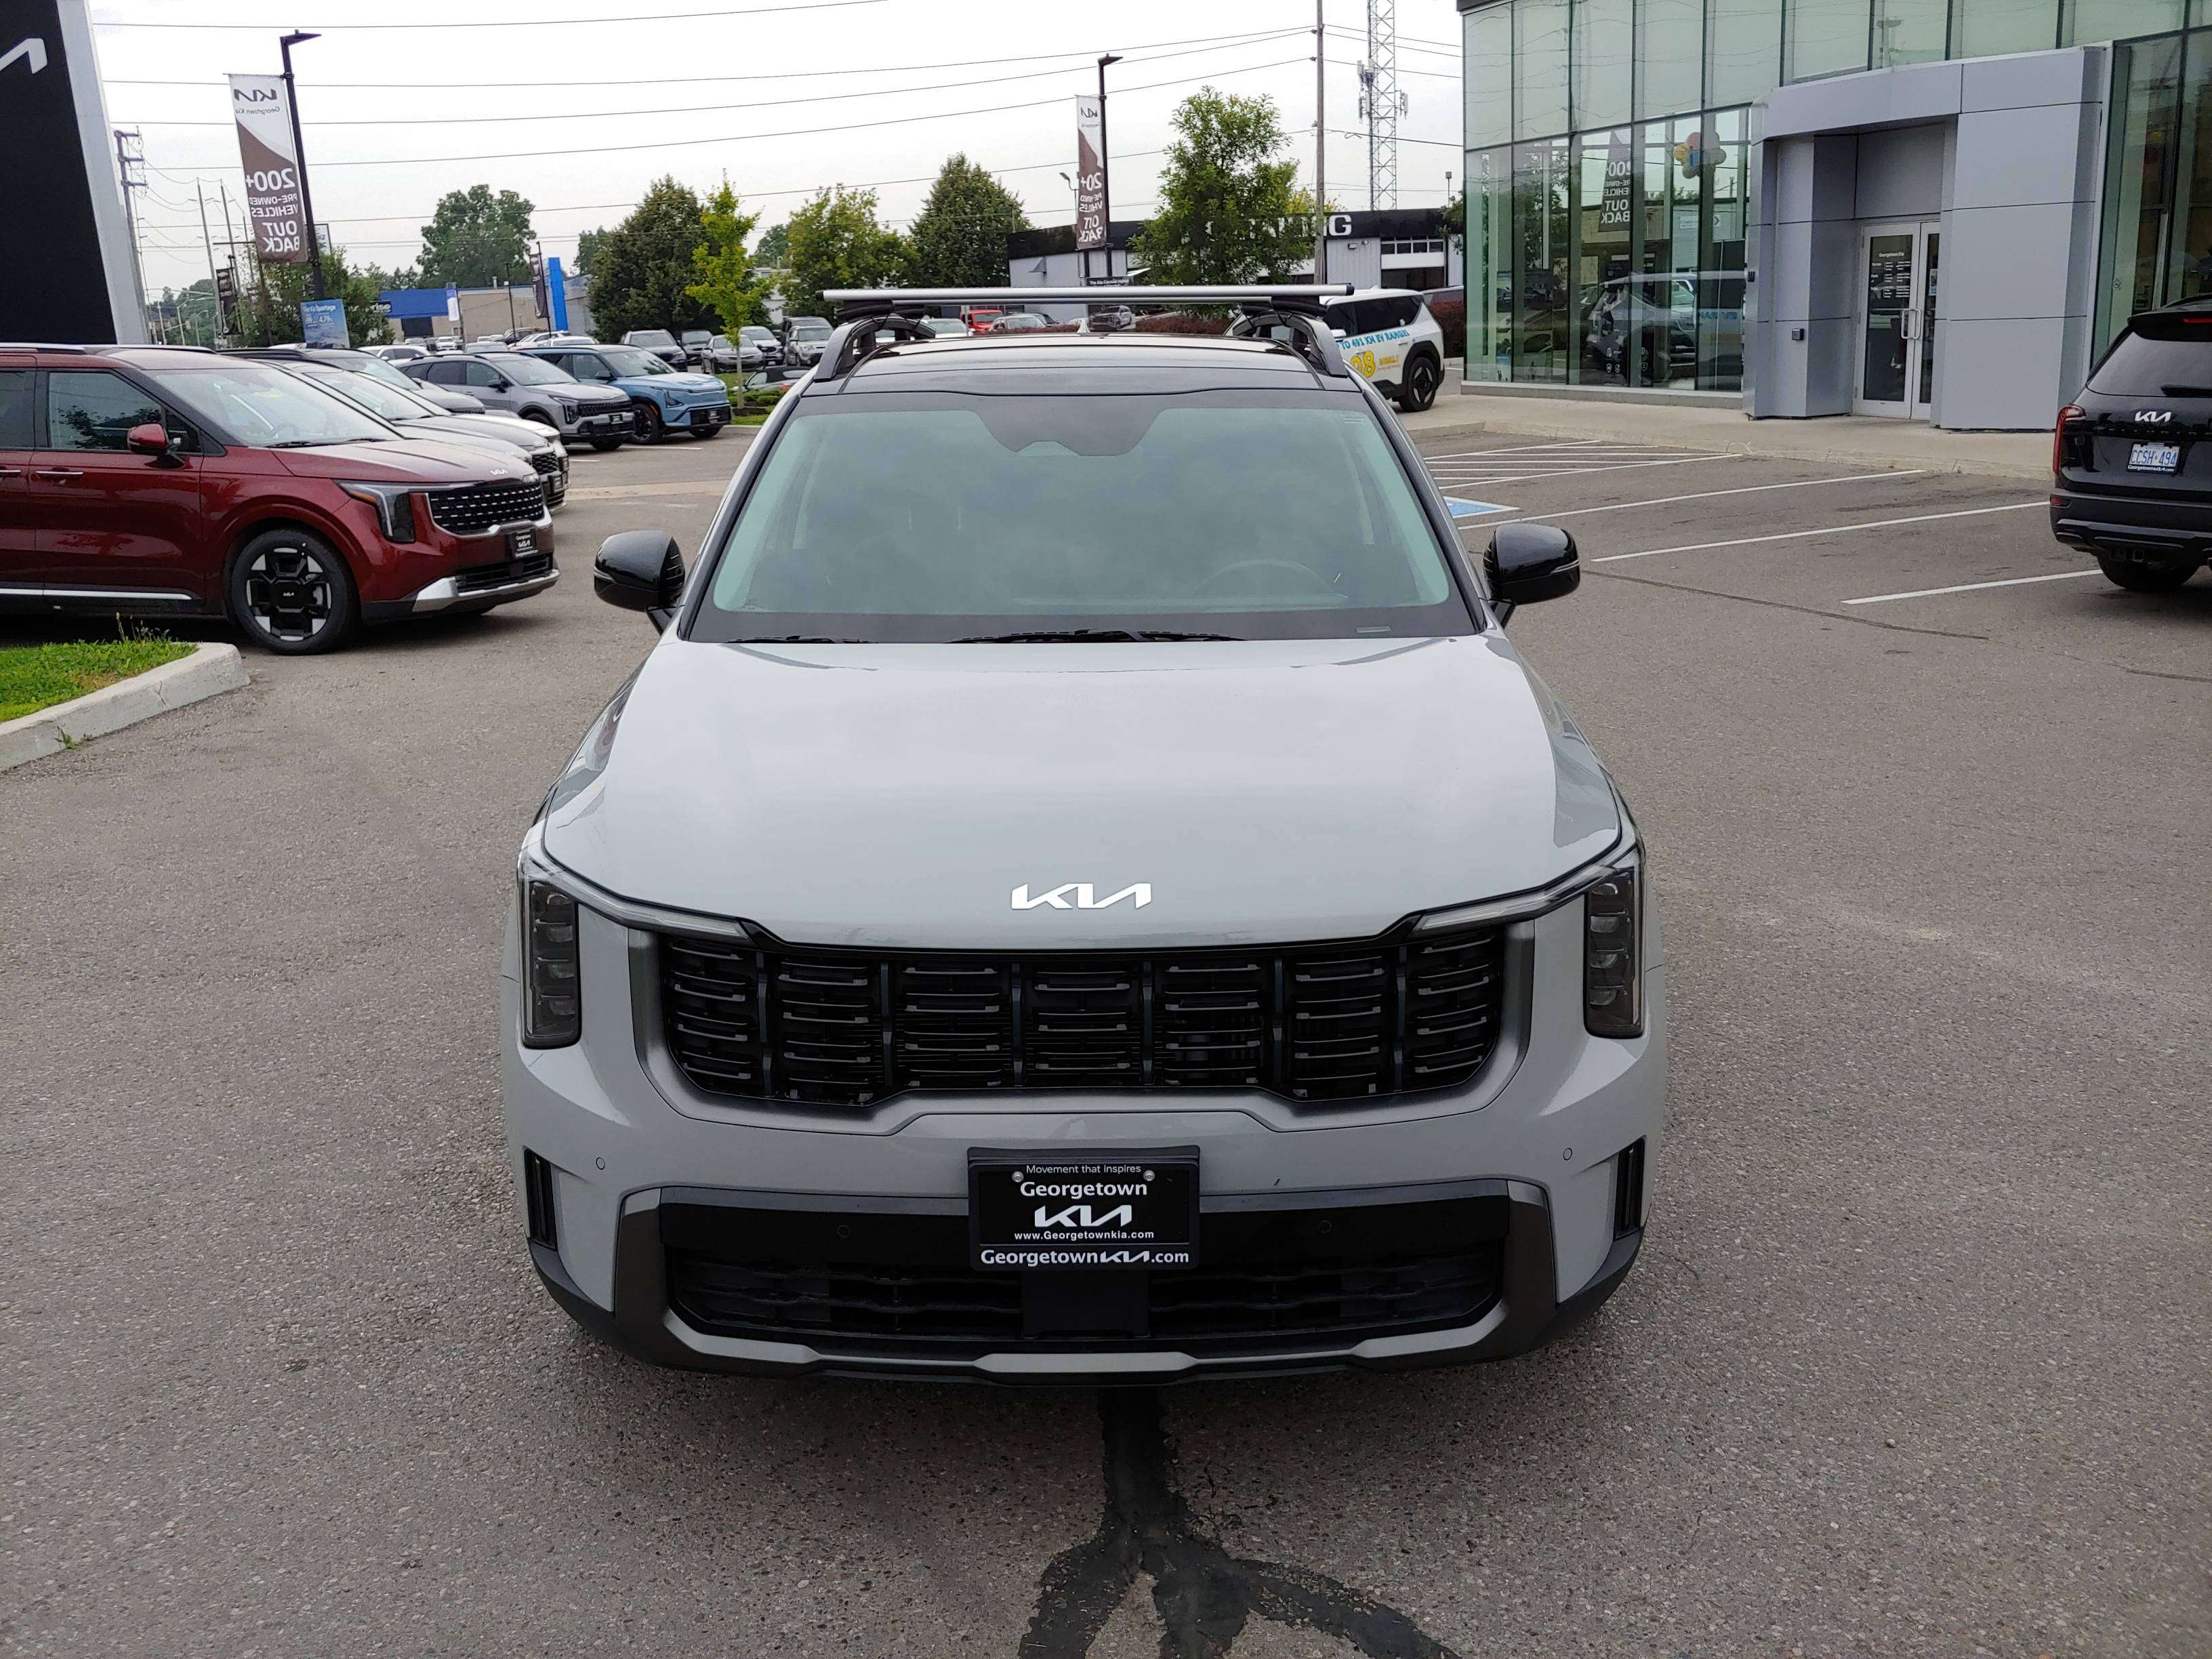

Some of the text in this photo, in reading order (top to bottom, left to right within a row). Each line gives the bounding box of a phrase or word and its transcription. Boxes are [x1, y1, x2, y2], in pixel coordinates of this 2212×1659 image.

[2134, 411, 2172, 423] KIA
[2131, 450, 2177, 466] CCSH 494
[1010, 882, 1152, 910] KIA
[1026, 1164, 1141, 1175] Movement that inspires
[1020, 1181, 1147, 1200] Georgetown
[1034, 1204, 1132, 1228] KIA
[1014, 1231, 1154, 1242] www.Georgetownkia.com
